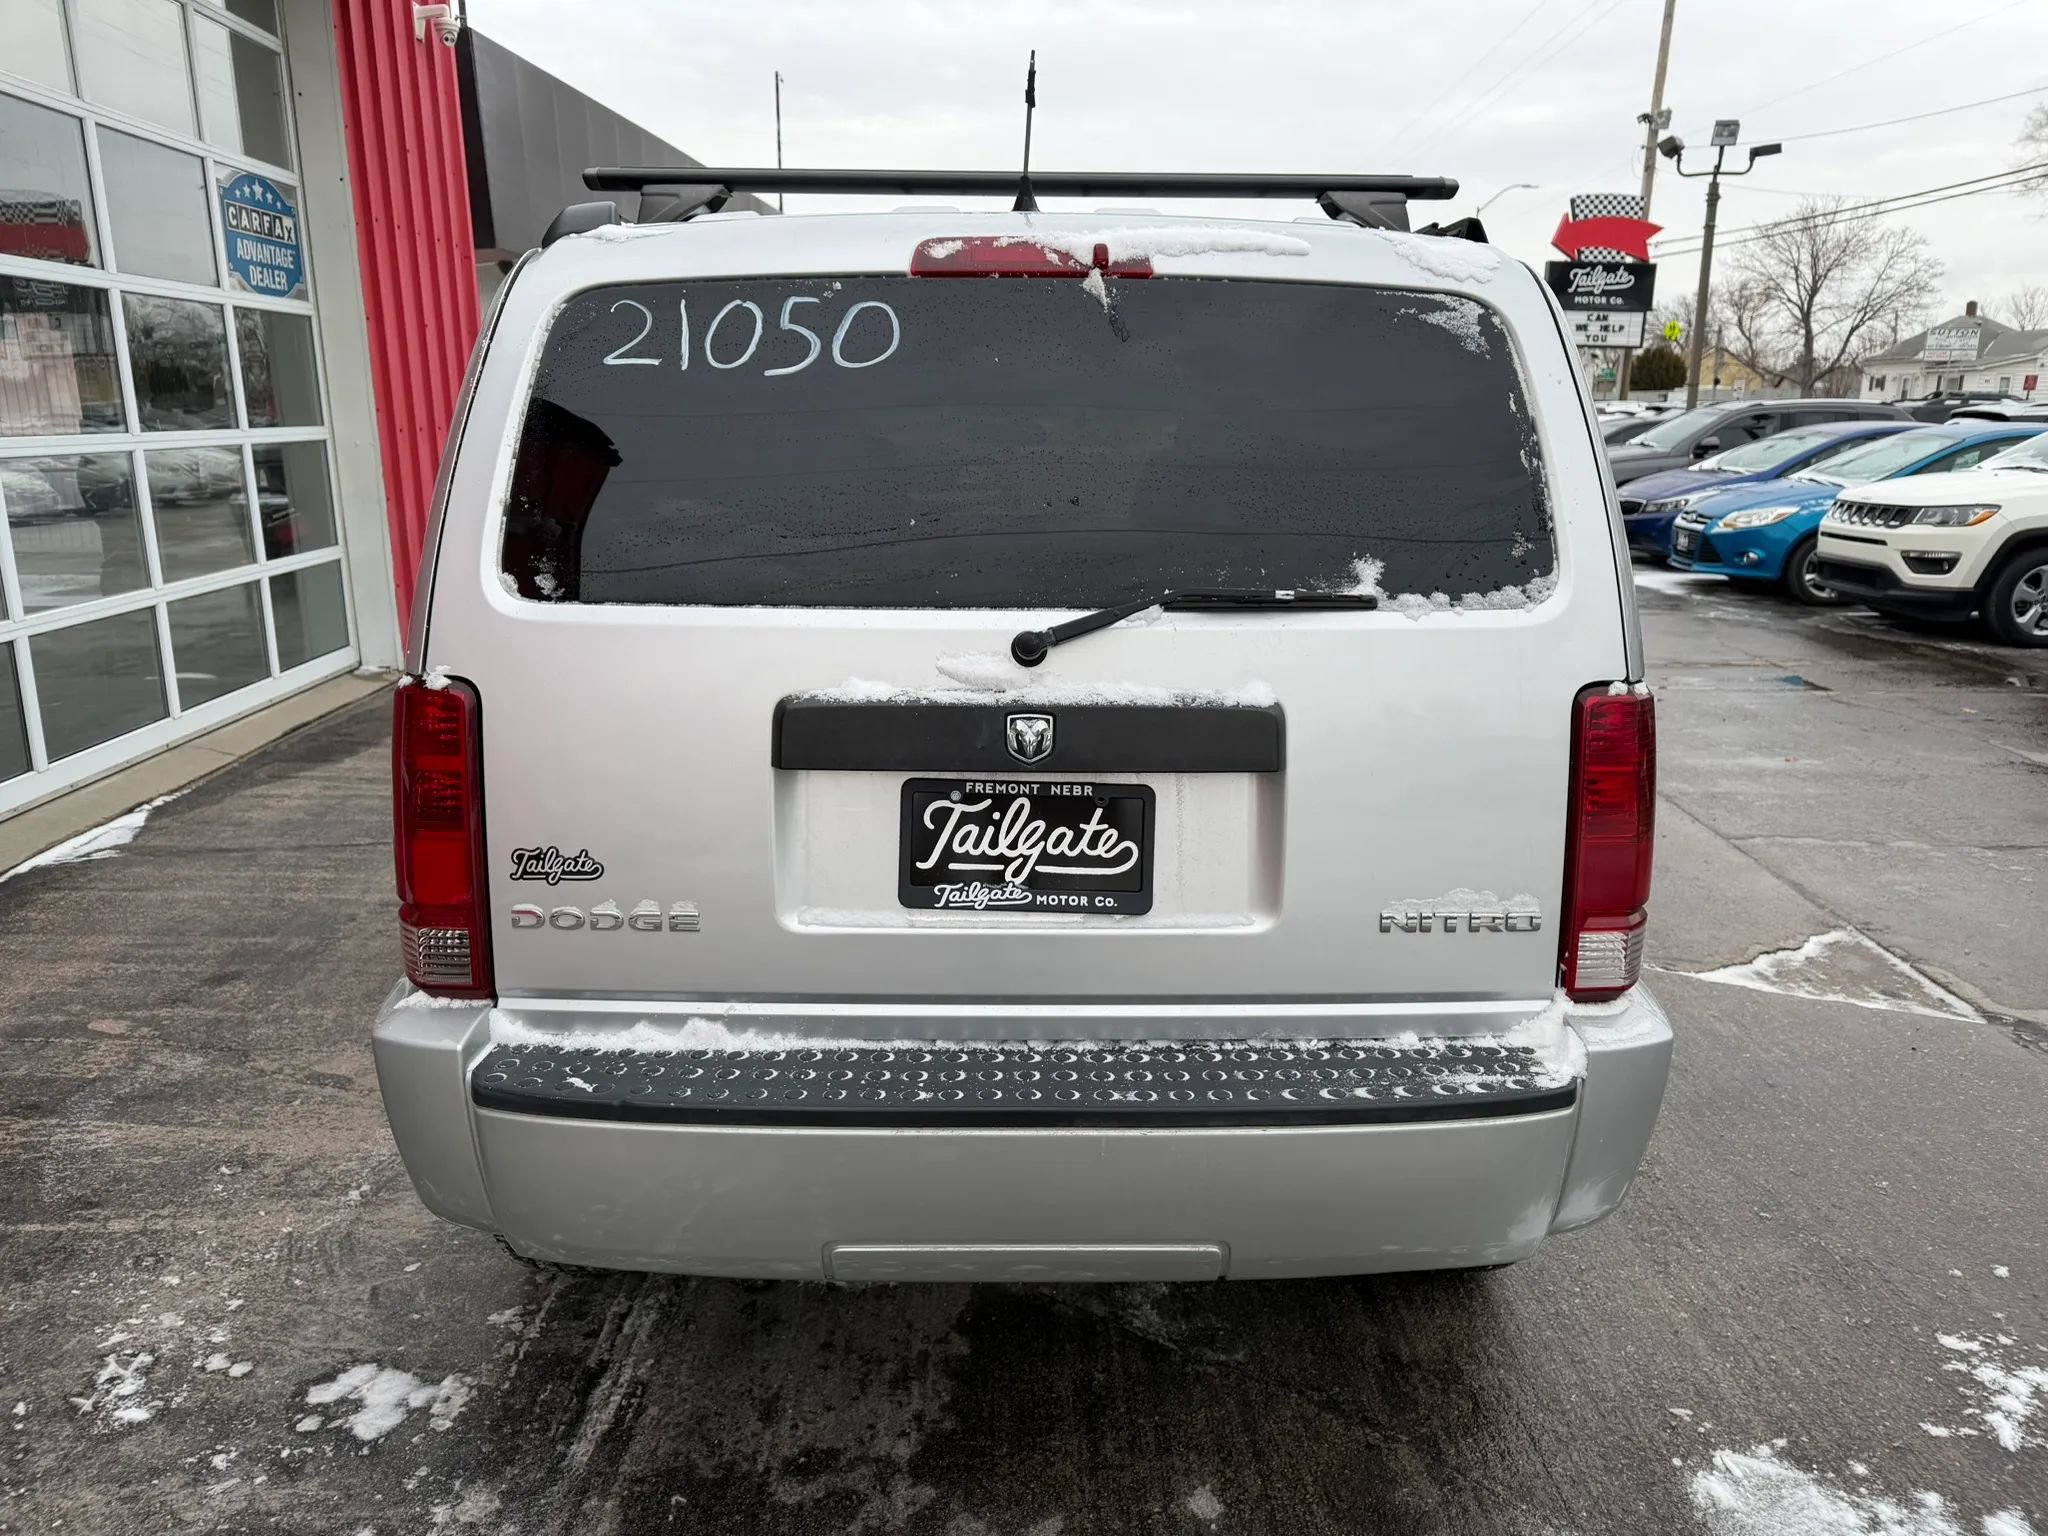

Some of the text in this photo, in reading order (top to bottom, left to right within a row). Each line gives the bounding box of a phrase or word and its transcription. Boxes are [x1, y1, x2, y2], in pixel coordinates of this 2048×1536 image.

[228, 206, 294, 243] CARFAX
[236, 237, 295, 270] ADVANTAGE
[249, 264, 288, 291] DEALER
[1567, 265, 1635, 293] Tailgate
[1574, 296, 1607, 305] MOTOR
[1575, 323, 1625, 333] WE HELP
[1587, 313, 1609, 322] CAN
[603, 296, 900, 376] 21050
[1585, 334, 1608, 343] YOU
[965, 782, 1094, 796] FREMONT NEBR
[915, 796, 1139, 885] Tailgate
[510, 846, 604, 886] Tailgate
[933, 881, 1033, 910] Tailgate
[1036, 895, 1089, 907] MOTOR
[511, 907, 701, 932] DODGE
[1379, 911, 1542, 933] NITRO
